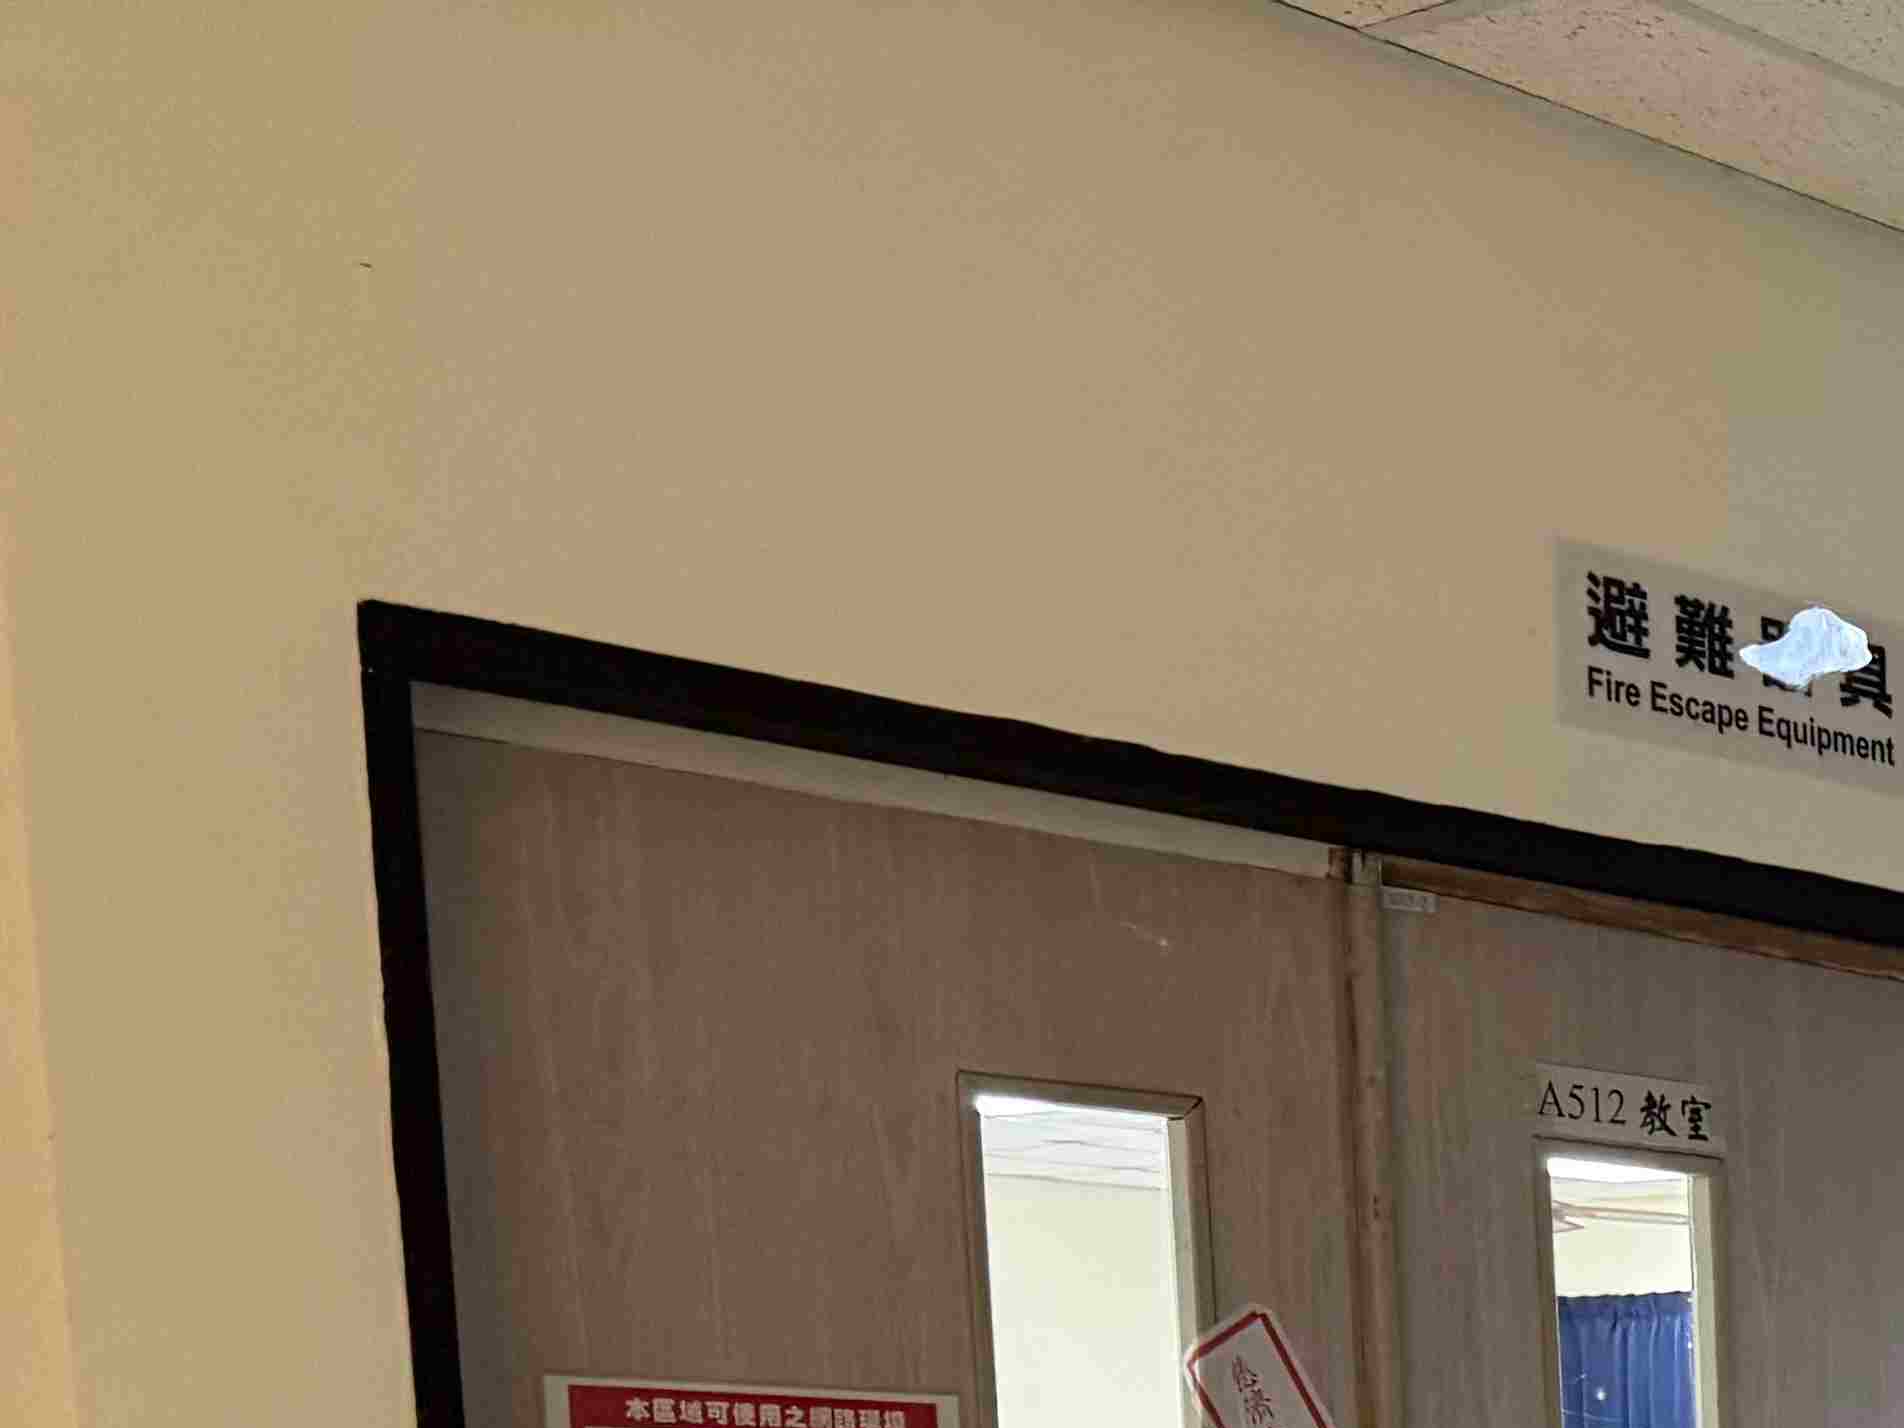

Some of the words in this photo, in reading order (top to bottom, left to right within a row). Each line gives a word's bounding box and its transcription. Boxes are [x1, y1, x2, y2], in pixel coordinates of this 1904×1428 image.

[1586, 571, 1893, 718] 避難具
[1587, 666, 1641, 708] Fire
[1650, 680, 1749, 734] Escape
[1758, 705, 1896, 767] Equipment
[1537, 1079, 1627, 1125] A512
[1640, 1089, 1713, 1142] 教室
